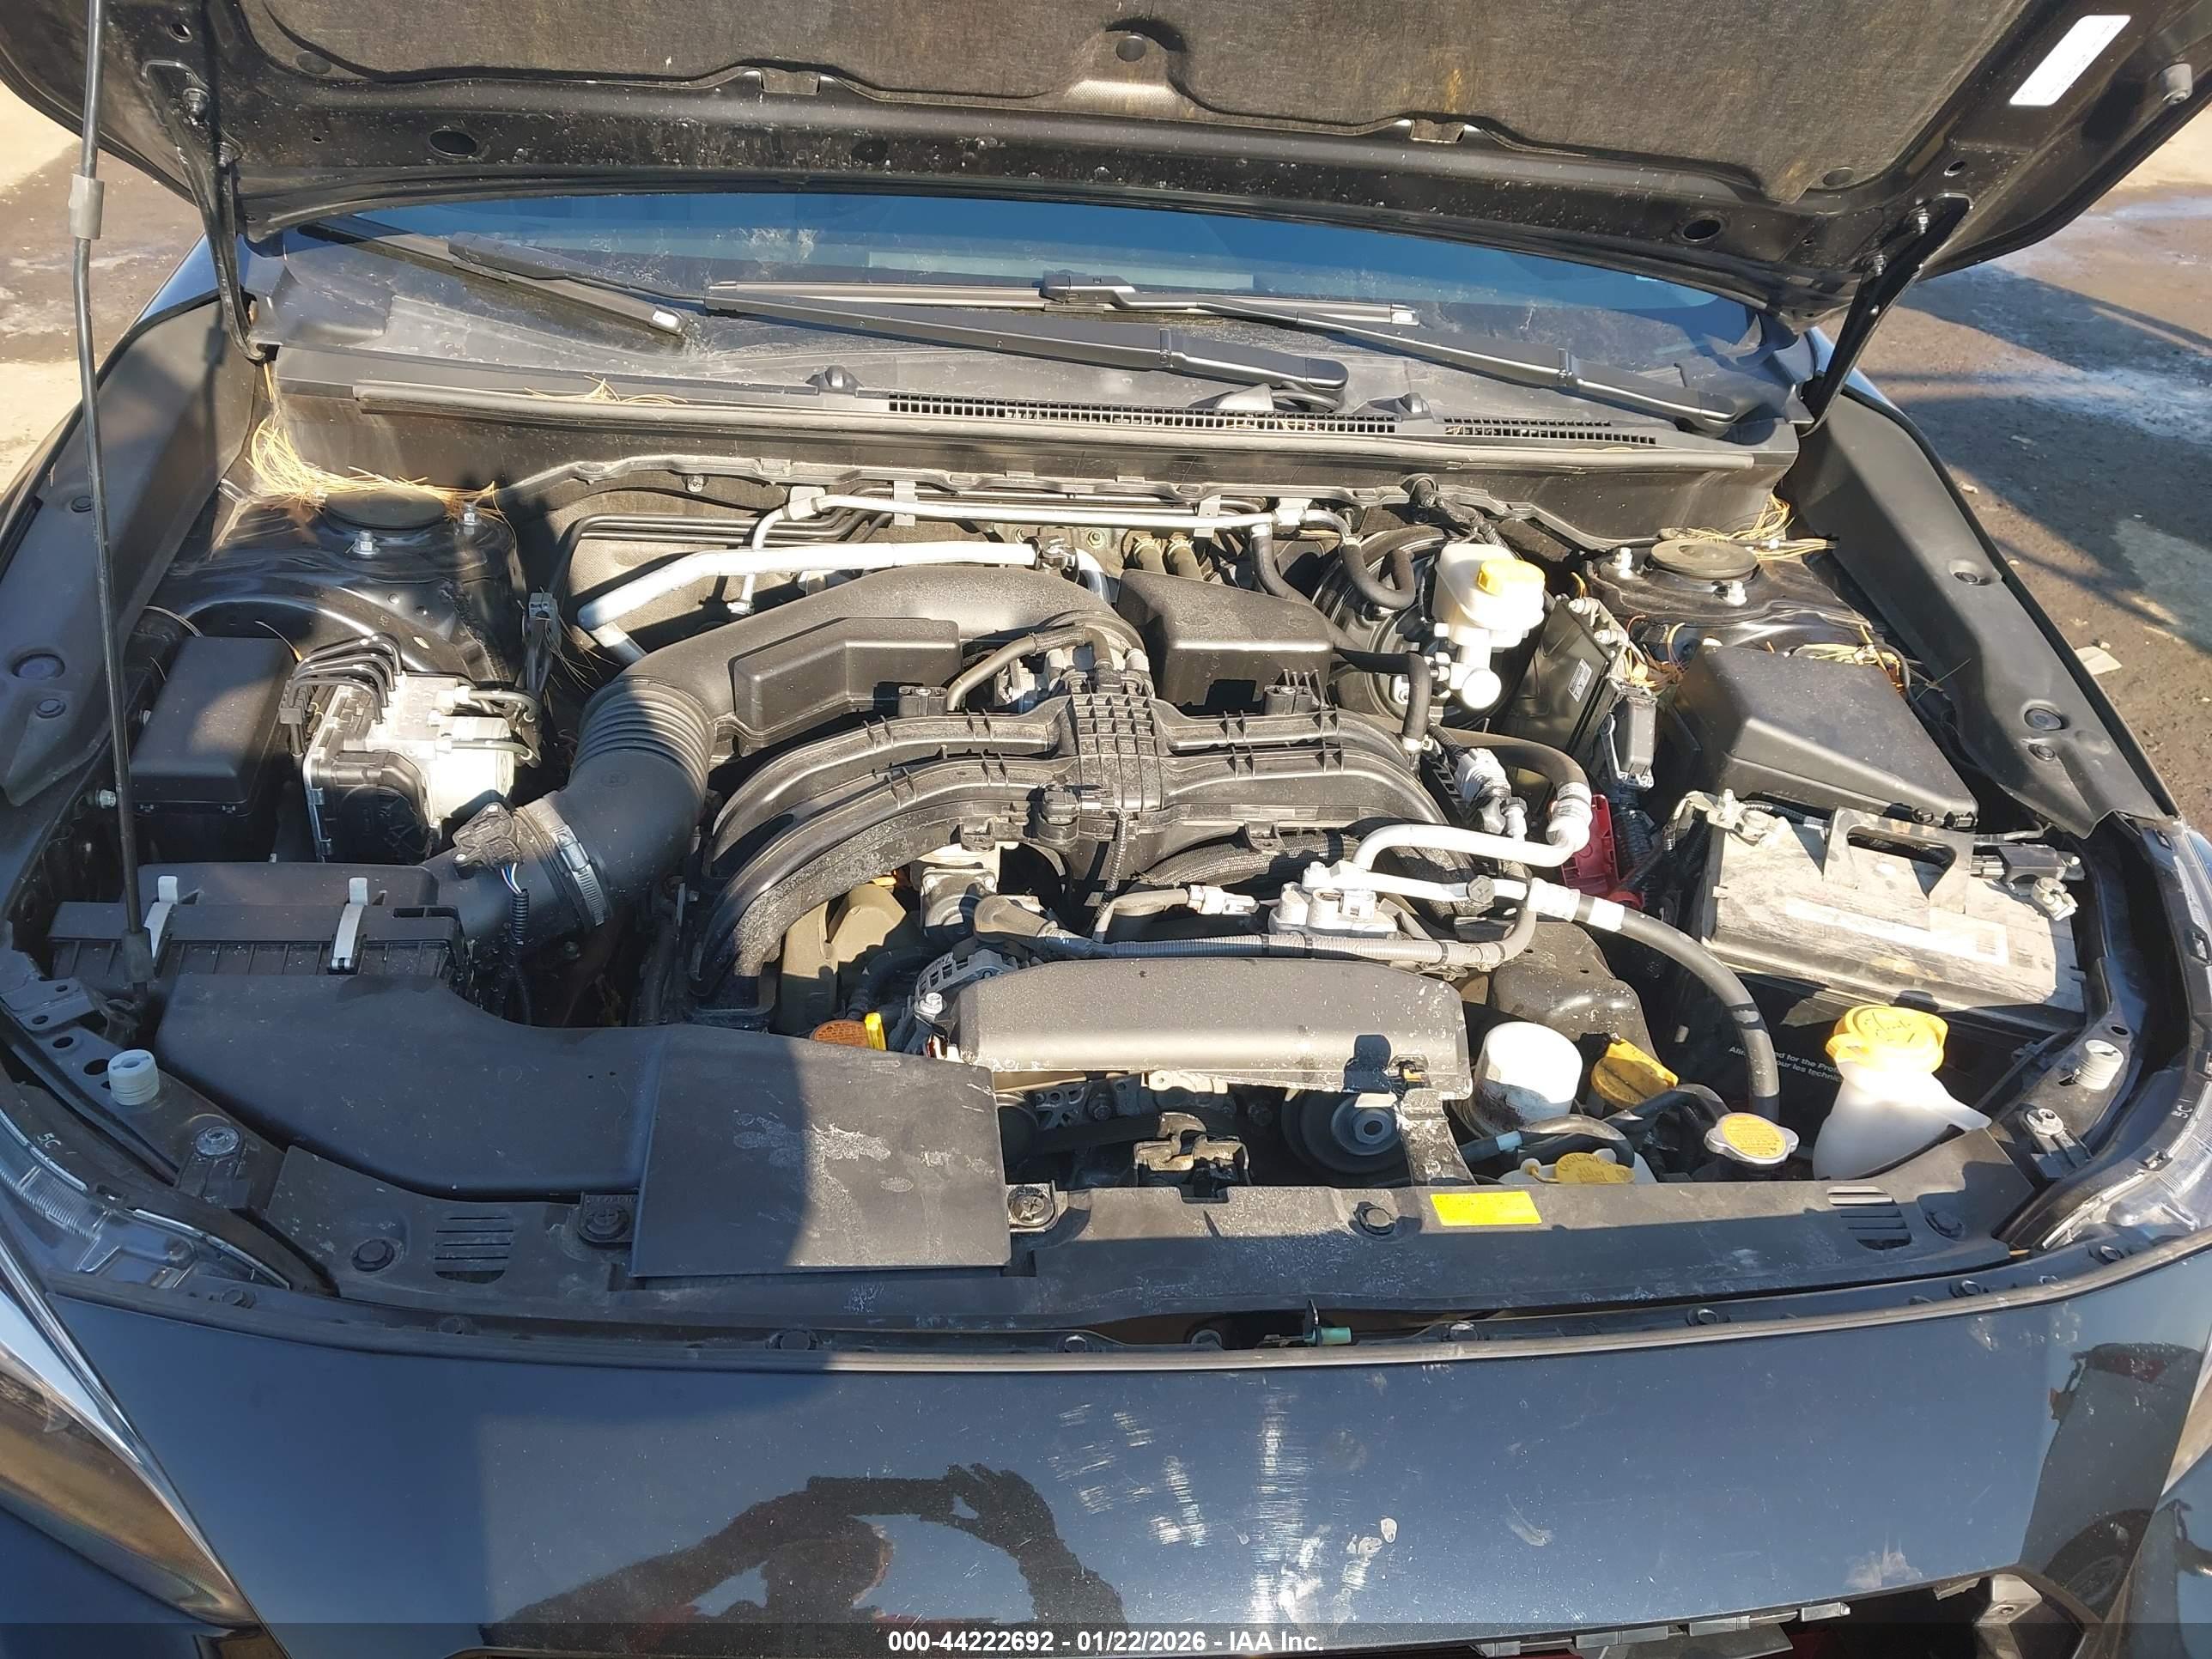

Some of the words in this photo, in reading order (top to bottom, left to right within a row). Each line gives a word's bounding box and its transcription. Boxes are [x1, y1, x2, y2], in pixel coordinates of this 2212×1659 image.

[1787, 1054, 1799, 1062] for
[1801, 1058, 1816, 1067] the
[1793, 1063, 1806, 1073] les
[1808, 1068, 1842, 1083] technic
